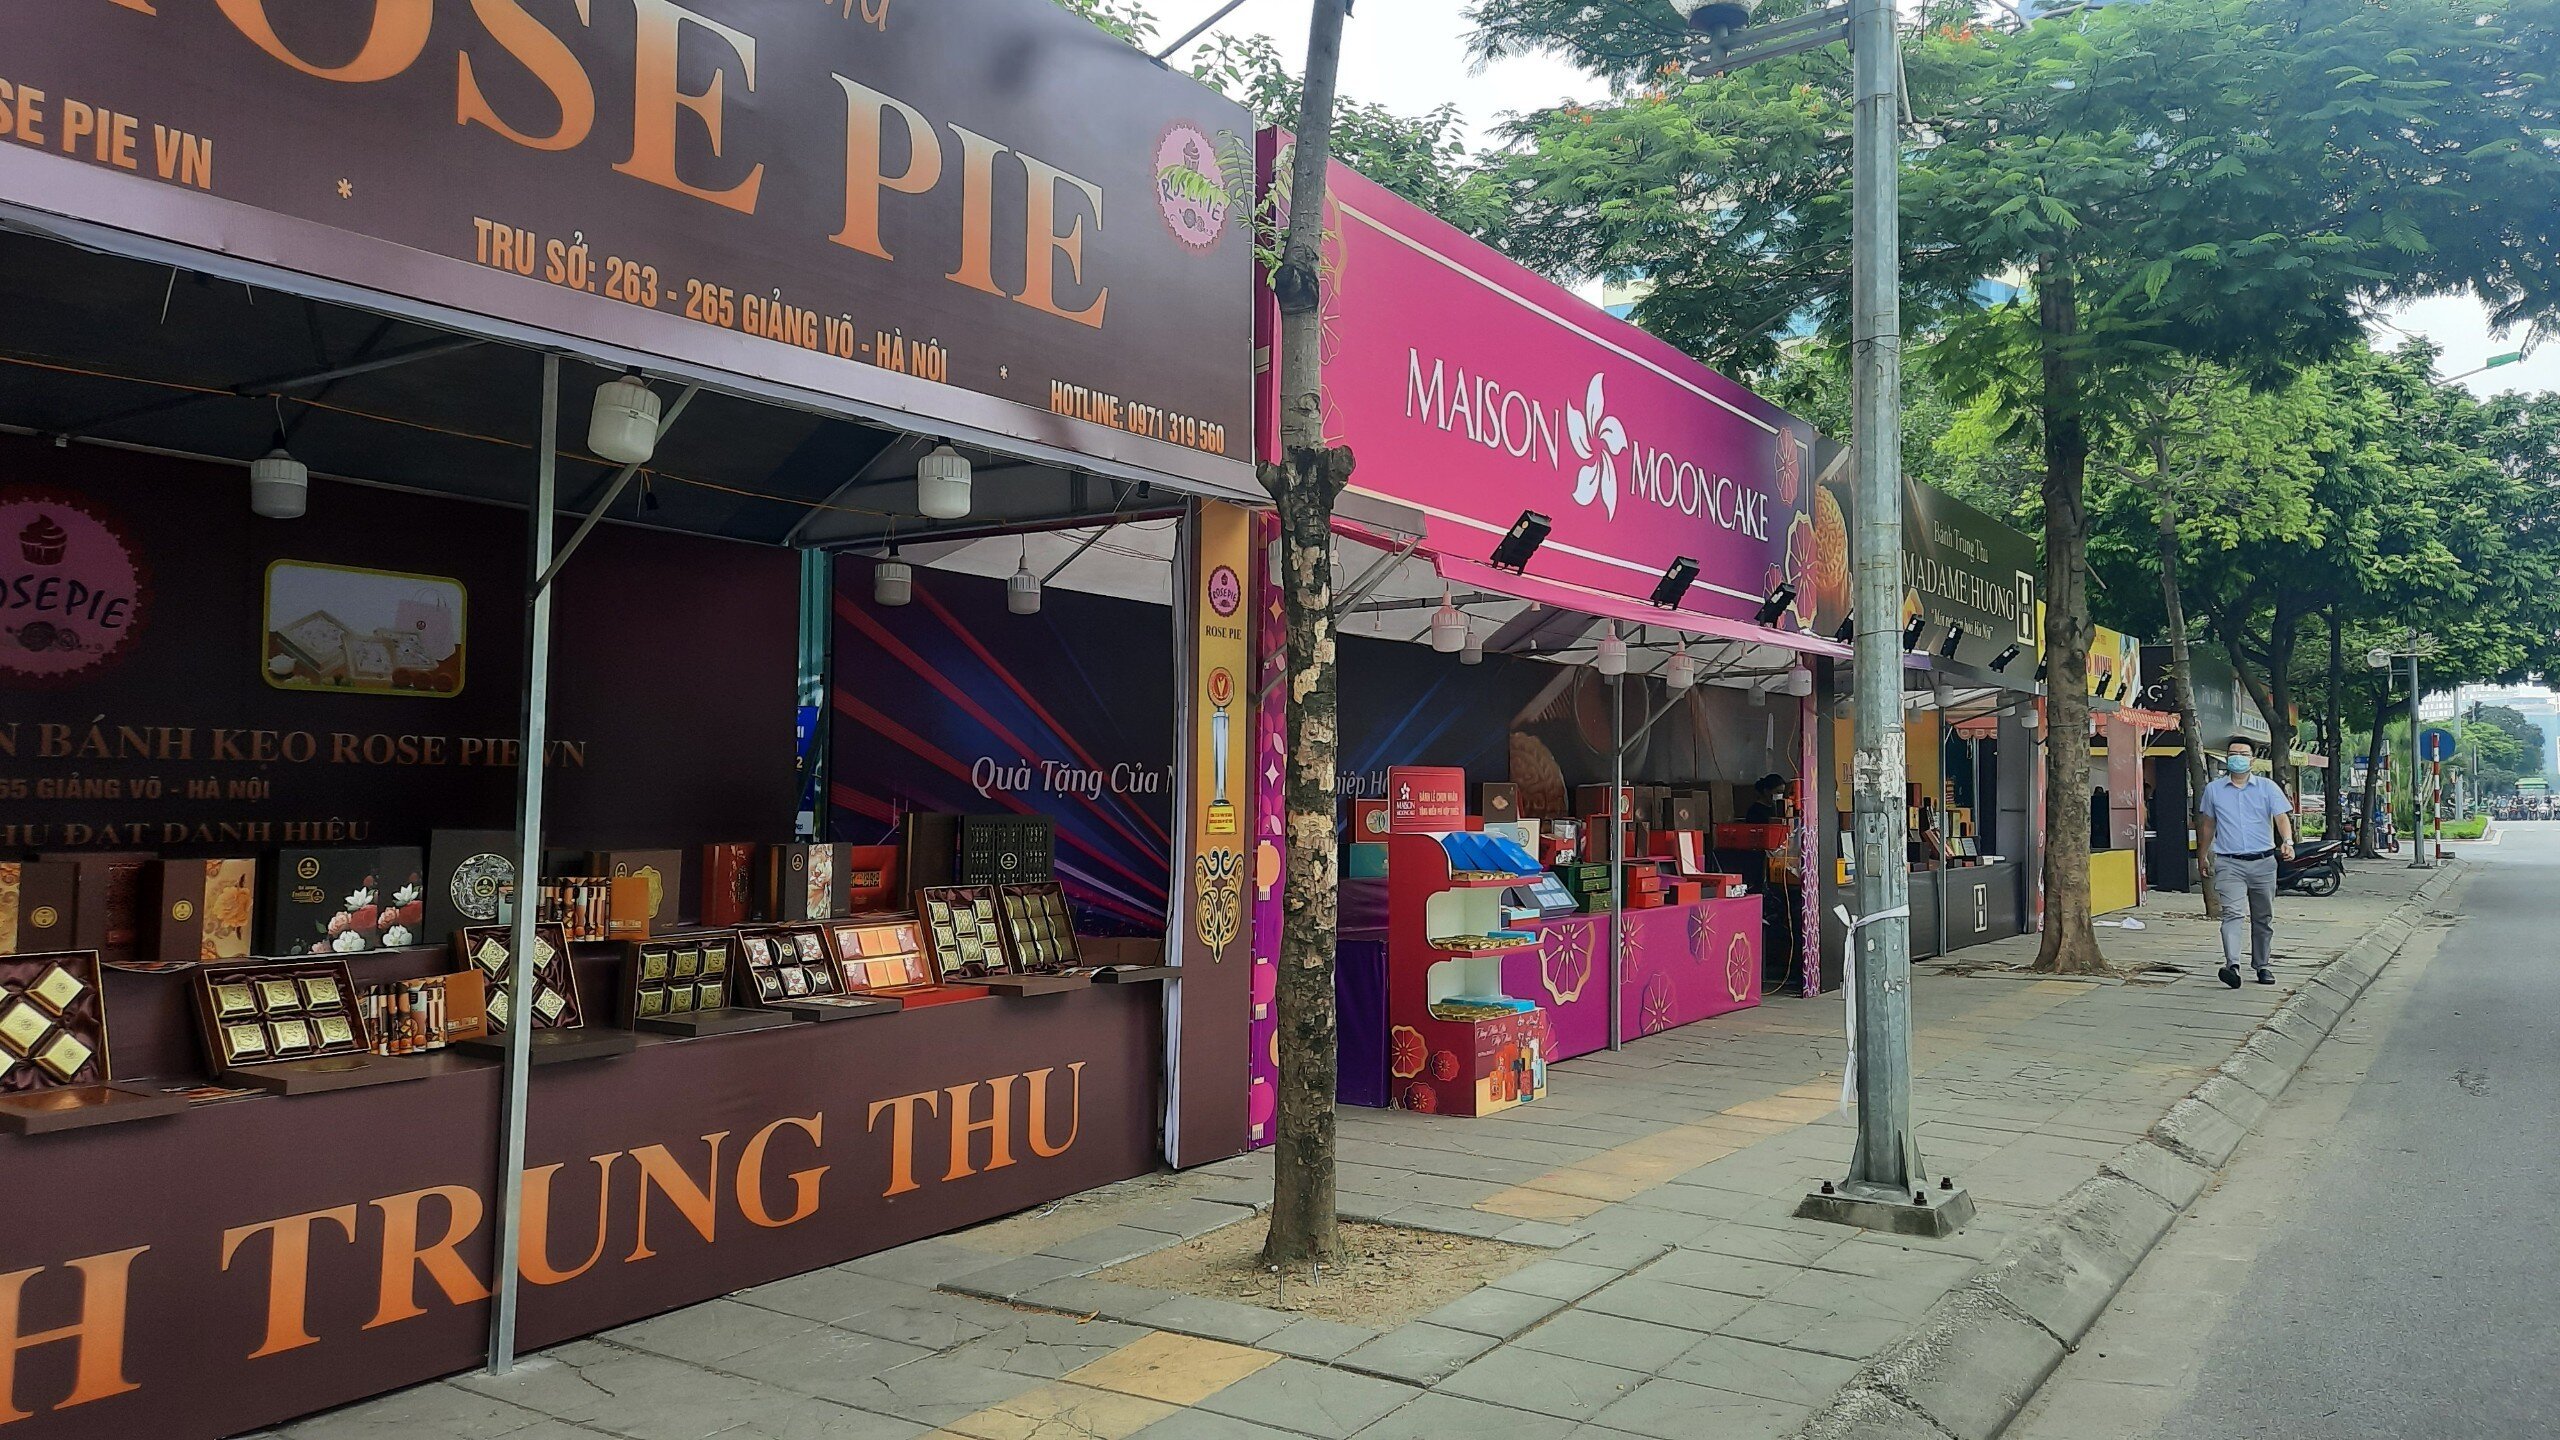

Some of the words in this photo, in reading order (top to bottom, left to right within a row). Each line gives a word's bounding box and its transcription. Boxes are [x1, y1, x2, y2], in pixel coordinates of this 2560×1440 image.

[62, 96, 139, 171] PIE
[154, 123, 213, 191] VN
[828, 70, 1110, 330] PIE
[604, 255, 658, 308] 263
[685, 278, 734, 328] 265
[742, 287, 818, 350] GIẢNG
[825, 313, 854, 360] VÕ
[876, 327, 906, 374] HÀ
[1051, 379, 1125, 430] HOTLINE:
[1128, 401, 1164, 442] 0971
[1169, 412, 1196, 448] 319
[1199, 420, 1226, 455] 560
[1405, 346, 1561, 472] MAISON
[1630, 440, 1770, 544] MOONCAKE
[1934, 520, 1953, 548] Bánh
[1953, 529, 1975, 563] Trung
[1903, 549, 1968, 605] MADAME
[1970, 574, 2015, 621] HUONG
[1205, 624, 1227, 639] ROSE
[1229, 627, 1242, 641] PIE
[37, 713, 198, 760] BÁNH
[211, 728, 318, 771] KẸO
[330, 731, 448, 766] ROSE
[459, 736, 521, 768] PIE
[36, 771, 121, 800] GIẢNG
[186, 775, 221, 800] HÀ
[228, 775, 271, 803] NỘI
[971, 756, 1031, 799] Quà
[1040, 759, 1104, 801] Tặng
[1111, 761, 1159, 794] Của
[160, 820, 272, 843] DANH
[282, 815, 370, 846] HIỆU
[0, 1243, 151, 1426] H
[221, 1110, 833, 1361] TRUNG
[866, 1060, 1087, 1202] THU
